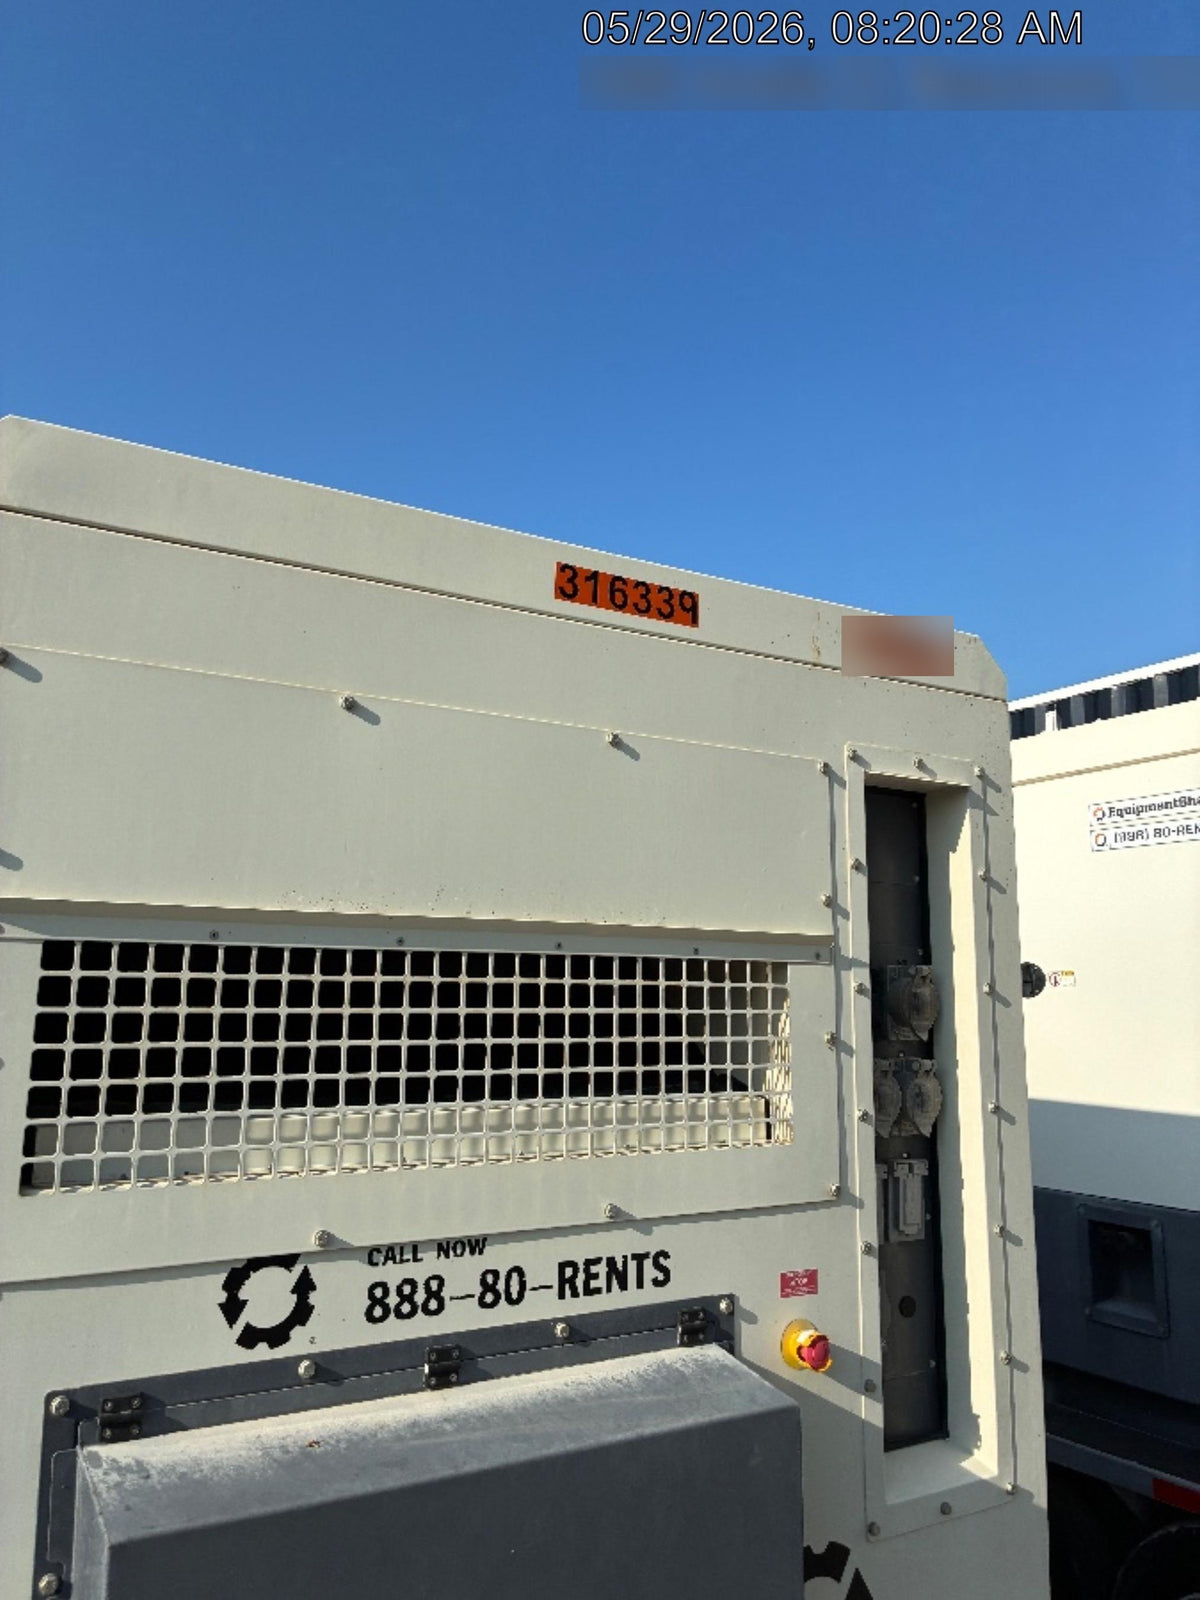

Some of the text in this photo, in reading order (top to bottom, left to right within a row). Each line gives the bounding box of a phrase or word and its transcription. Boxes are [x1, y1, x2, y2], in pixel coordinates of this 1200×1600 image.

[558, 563, 699, 625] 316339
[367, 1237, 488, 1267] CALL NOW
[364, 1249, 672, 1325] 888-80-RENTS
